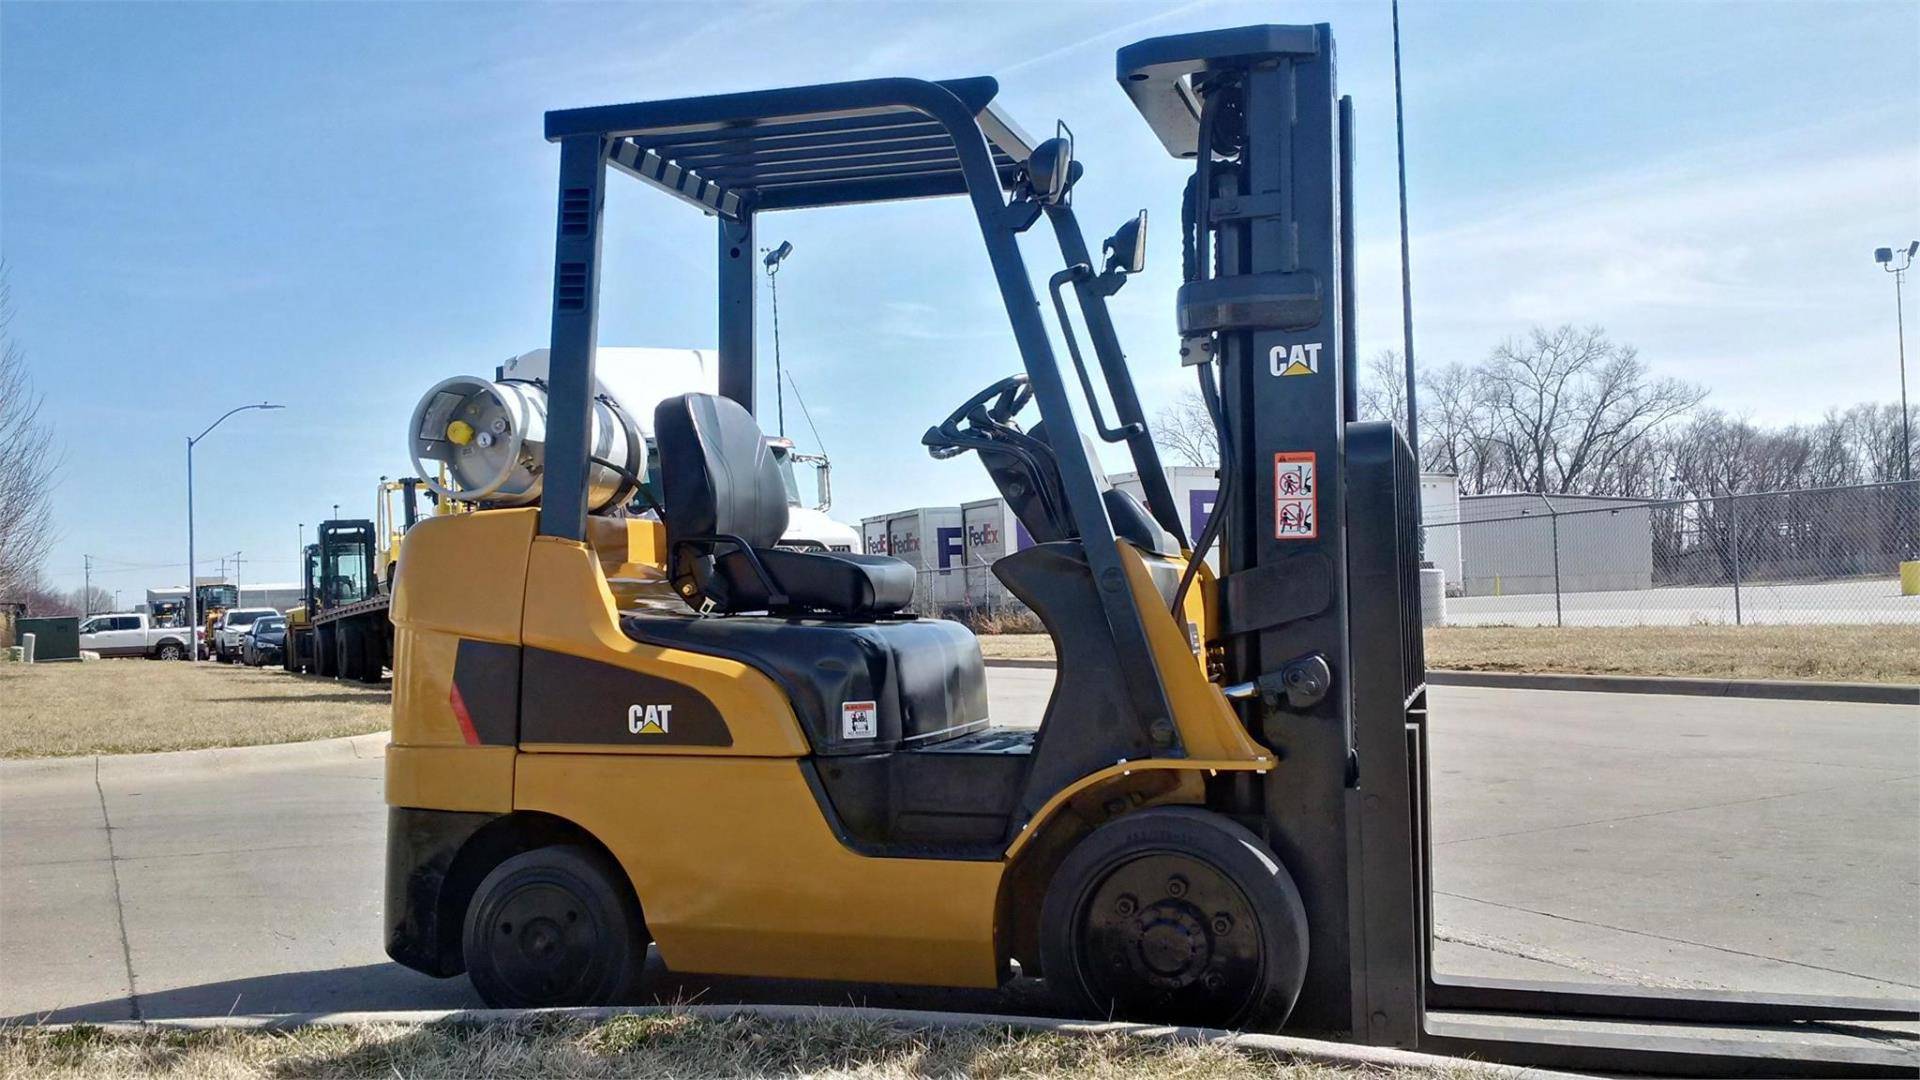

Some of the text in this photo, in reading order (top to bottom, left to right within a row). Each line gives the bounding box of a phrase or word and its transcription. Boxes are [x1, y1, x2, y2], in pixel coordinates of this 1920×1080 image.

[1269, 343, 1322, 376] CAT
[867, 534, 887, 555] FedE
[892, 532, 920, 554] FedEx
[968, 523, 998, 546] FedEx
[628, 704, 671, 734] CAT
